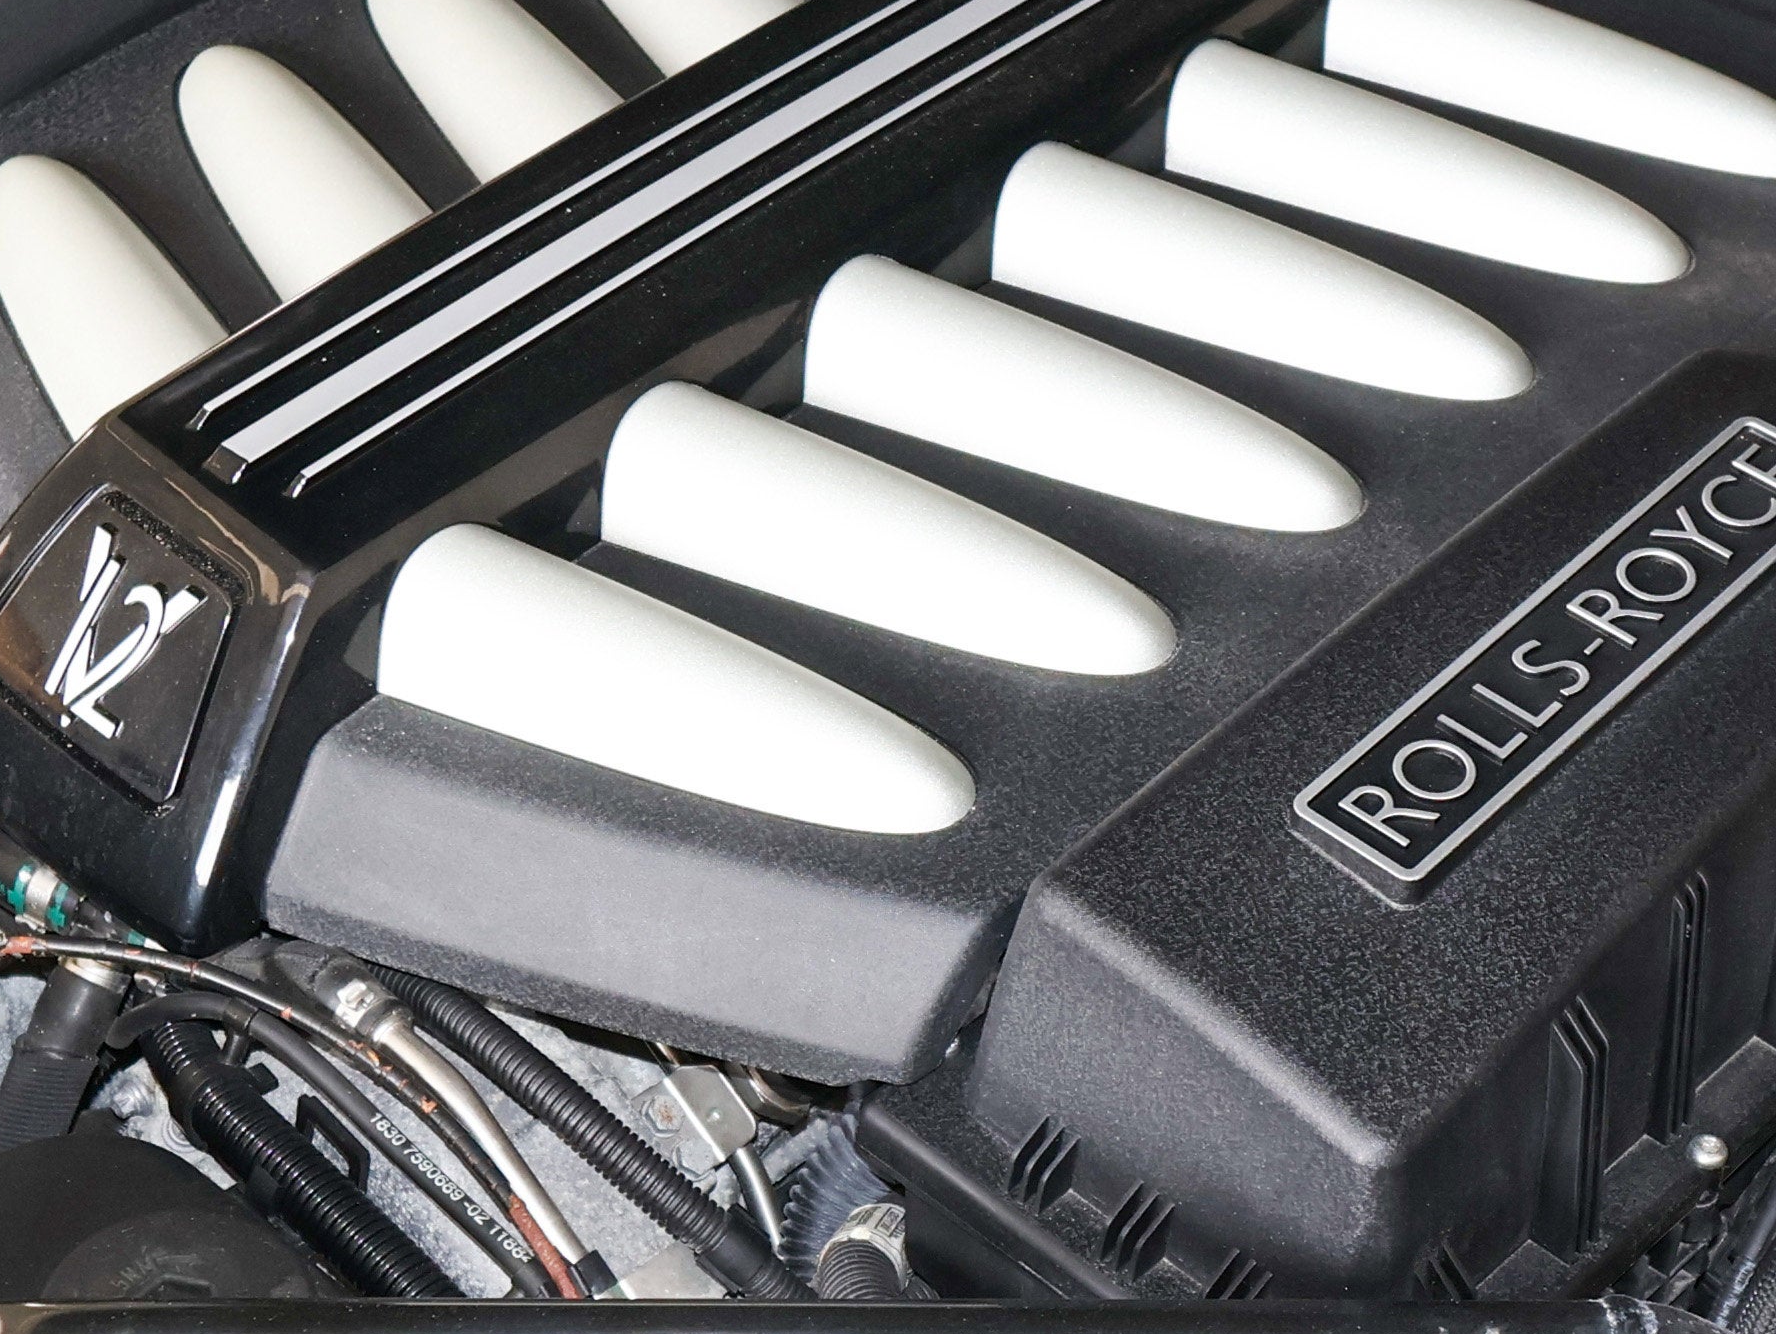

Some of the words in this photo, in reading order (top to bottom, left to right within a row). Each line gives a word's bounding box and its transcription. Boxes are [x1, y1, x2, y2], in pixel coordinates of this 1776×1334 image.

[369, 1112, 407, 1147] 1830
[402, 1145, 466, 1202] 7590689
[463, 1201, 491, 1226] -02
